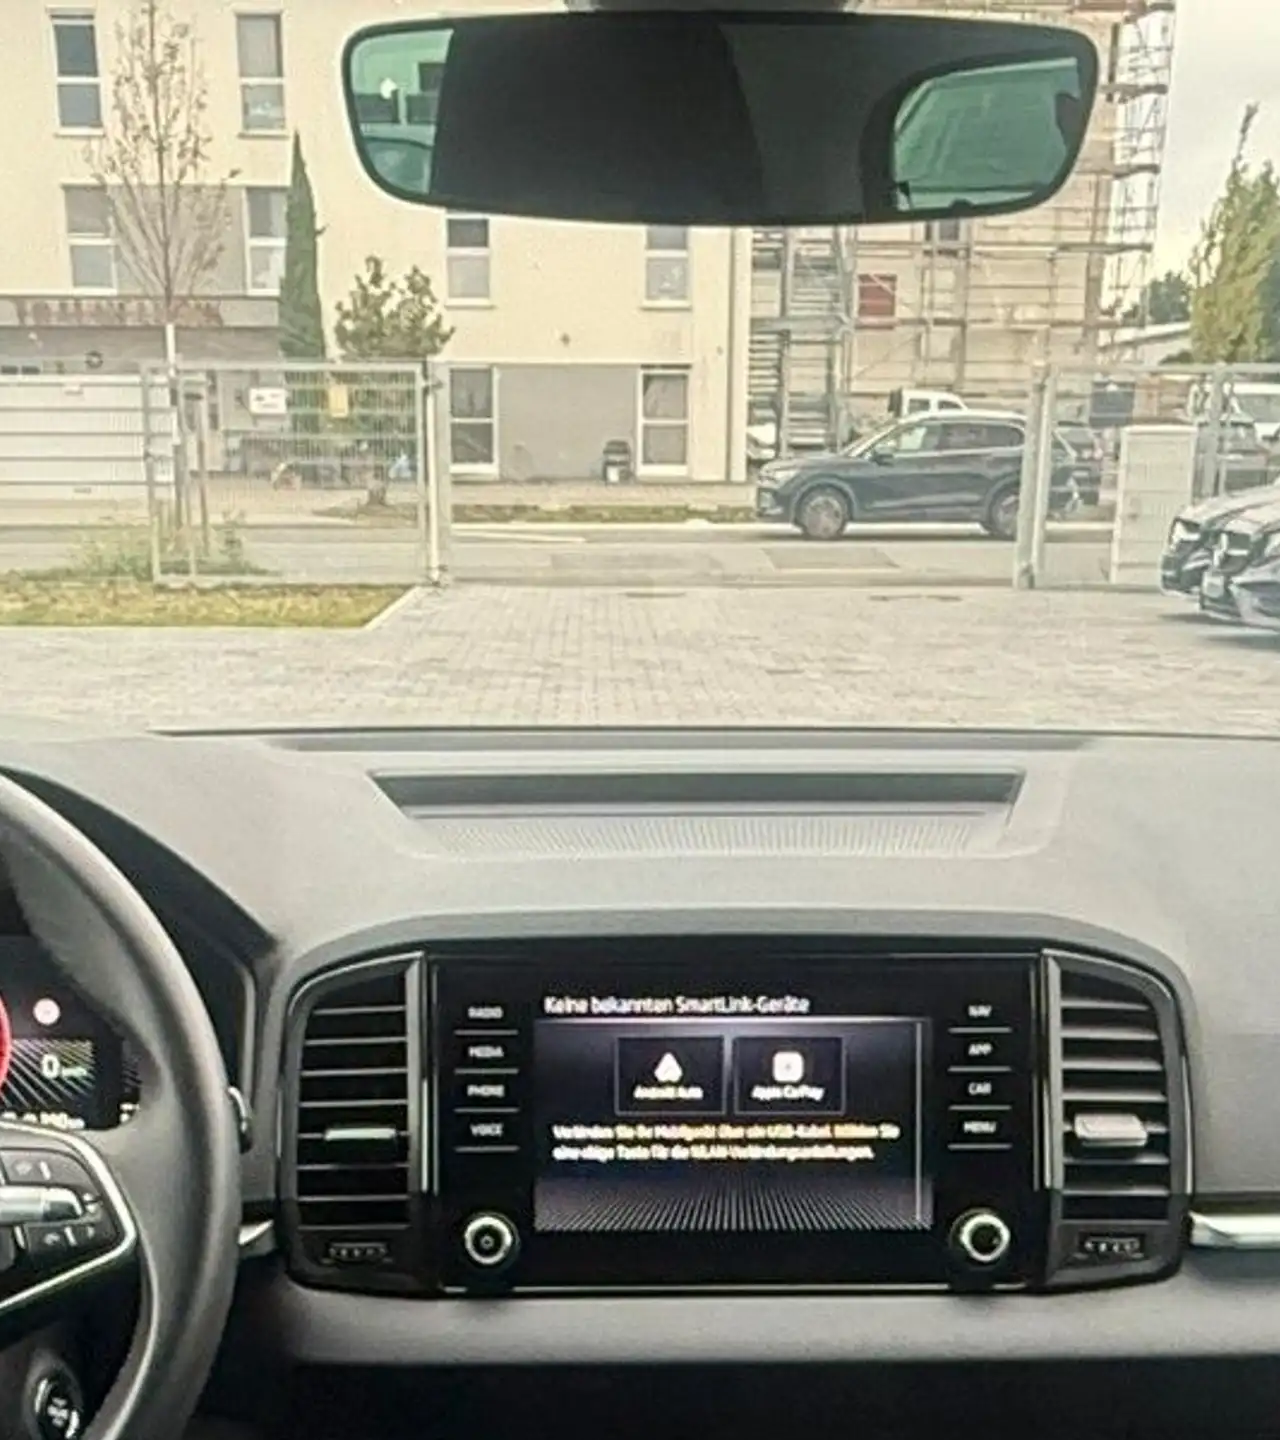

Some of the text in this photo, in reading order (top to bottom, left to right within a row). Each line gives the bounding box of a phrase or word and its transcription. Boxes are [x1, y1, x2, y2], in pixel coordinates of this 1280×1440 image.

[543, 996, 811, 1014] Keine bekannten SmartLink-Geräte
[967, 1004, 992, 1017] NAV
[467, 1005, 504, 1019] RADIO
[468, 1045, 505, 1058] MEDIA
[967, 1043, 993, 1056] APP
[41, 1053, 61, 1080] 0
[466, 1084, 505, 1098] PHONE
[967, 1082, 992, 1095] CAR
[469, 1123, 504, 1137] VOICE
[963, 1120, 997, 1133] MENU
